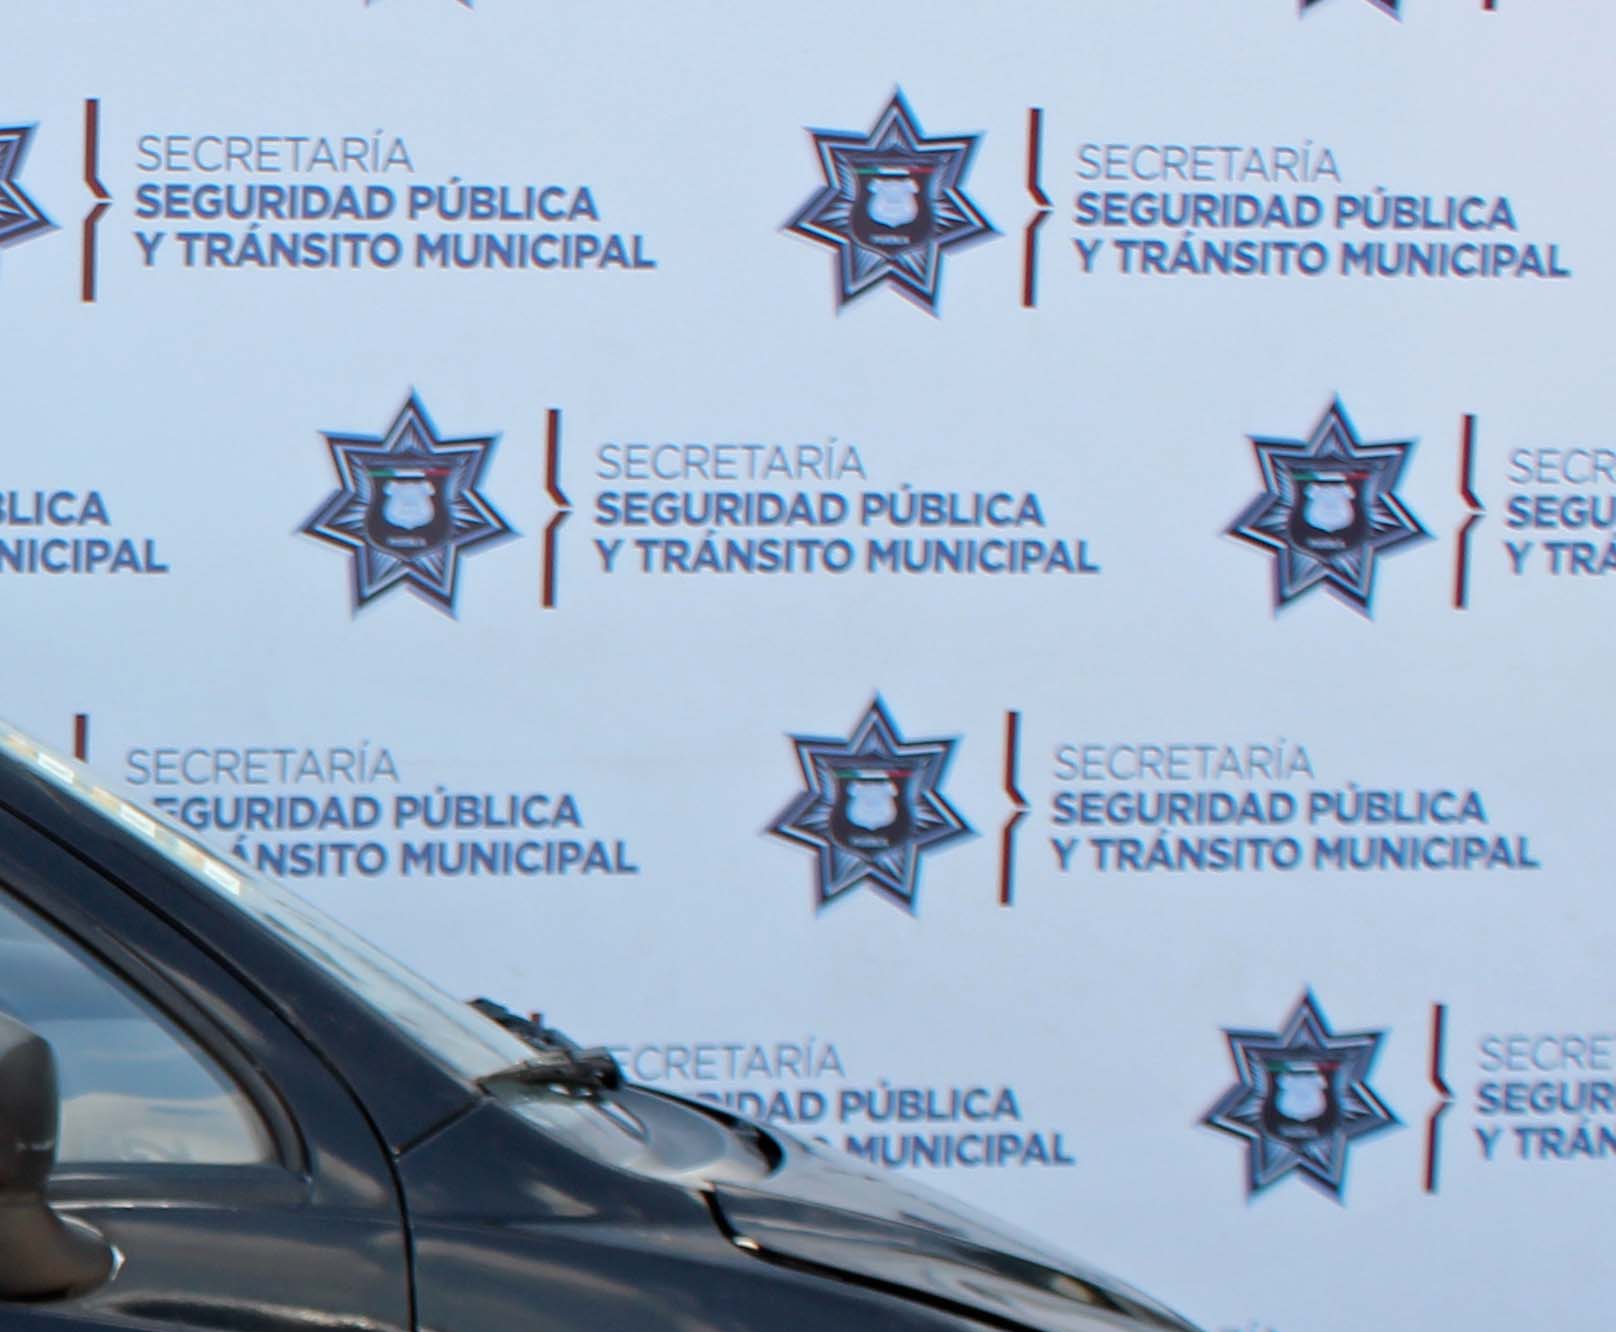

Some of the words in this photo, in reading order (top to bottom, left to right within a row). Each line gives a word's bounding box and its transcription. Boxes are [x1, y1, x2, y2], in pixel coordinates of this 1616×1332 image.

[136, 128, 414, 173] SECRETARÍA
[1076, 139, 1342, 183] SECRETARÍA
[135, 184, 397, 222] SEGURIDAD
[408, 176, 600, 222] PÚBLICA
[1075, 190, 1324, 229] SEGURIDAD
[1335, 186, 1517, 231] PÚBLICA
[134, 230, 166, 267] Y
[175, 222, 403, 268] TRÁNSITO
[415, 232, 657, 269] MUNICIPAL
[1074, 238, 1104, 273] Y
[1113, 230, 1330, 276] TRÁNSITO
[1341, 241, 1571, 278] MUNICIPAL
[596, 437, 867, 481] SECRETARÍA
[595, 490, 849, 526] SEGURIDAD
[860, 483, 1046, 527] PÚBLICA
[594, 538, 624, 573] Y
[633, 529, 856, 573] TRÁNSITO
[867, 538, 1100, 574] MUNICIPAL
[125, 740, 400, 786] SECRETARÍA
[1054, 737, 1315, 782] SECRETARÍA
[394, 785, 583, 829] PÚBLICA
[1052, 791, 1297, 826] SEGURIDAD
[1308, 783, 1487, 825] PÚBLICA
[400, 839, 639, 876] MUNICIPAL
[1050, 837, 1079, 871] Y
[1090, 829, 1303, 871] TRÁNSITO
[1314, 835, 1540, 870] MUNICIPAL
[1479, 1033, 1616, 1073] SECRE
[838, 1081, 1021, 1123] PÚBLICA
[1477, 1080, 1616, 1115] SEGUR
[1475, 1127, 1502, 1160] Y
